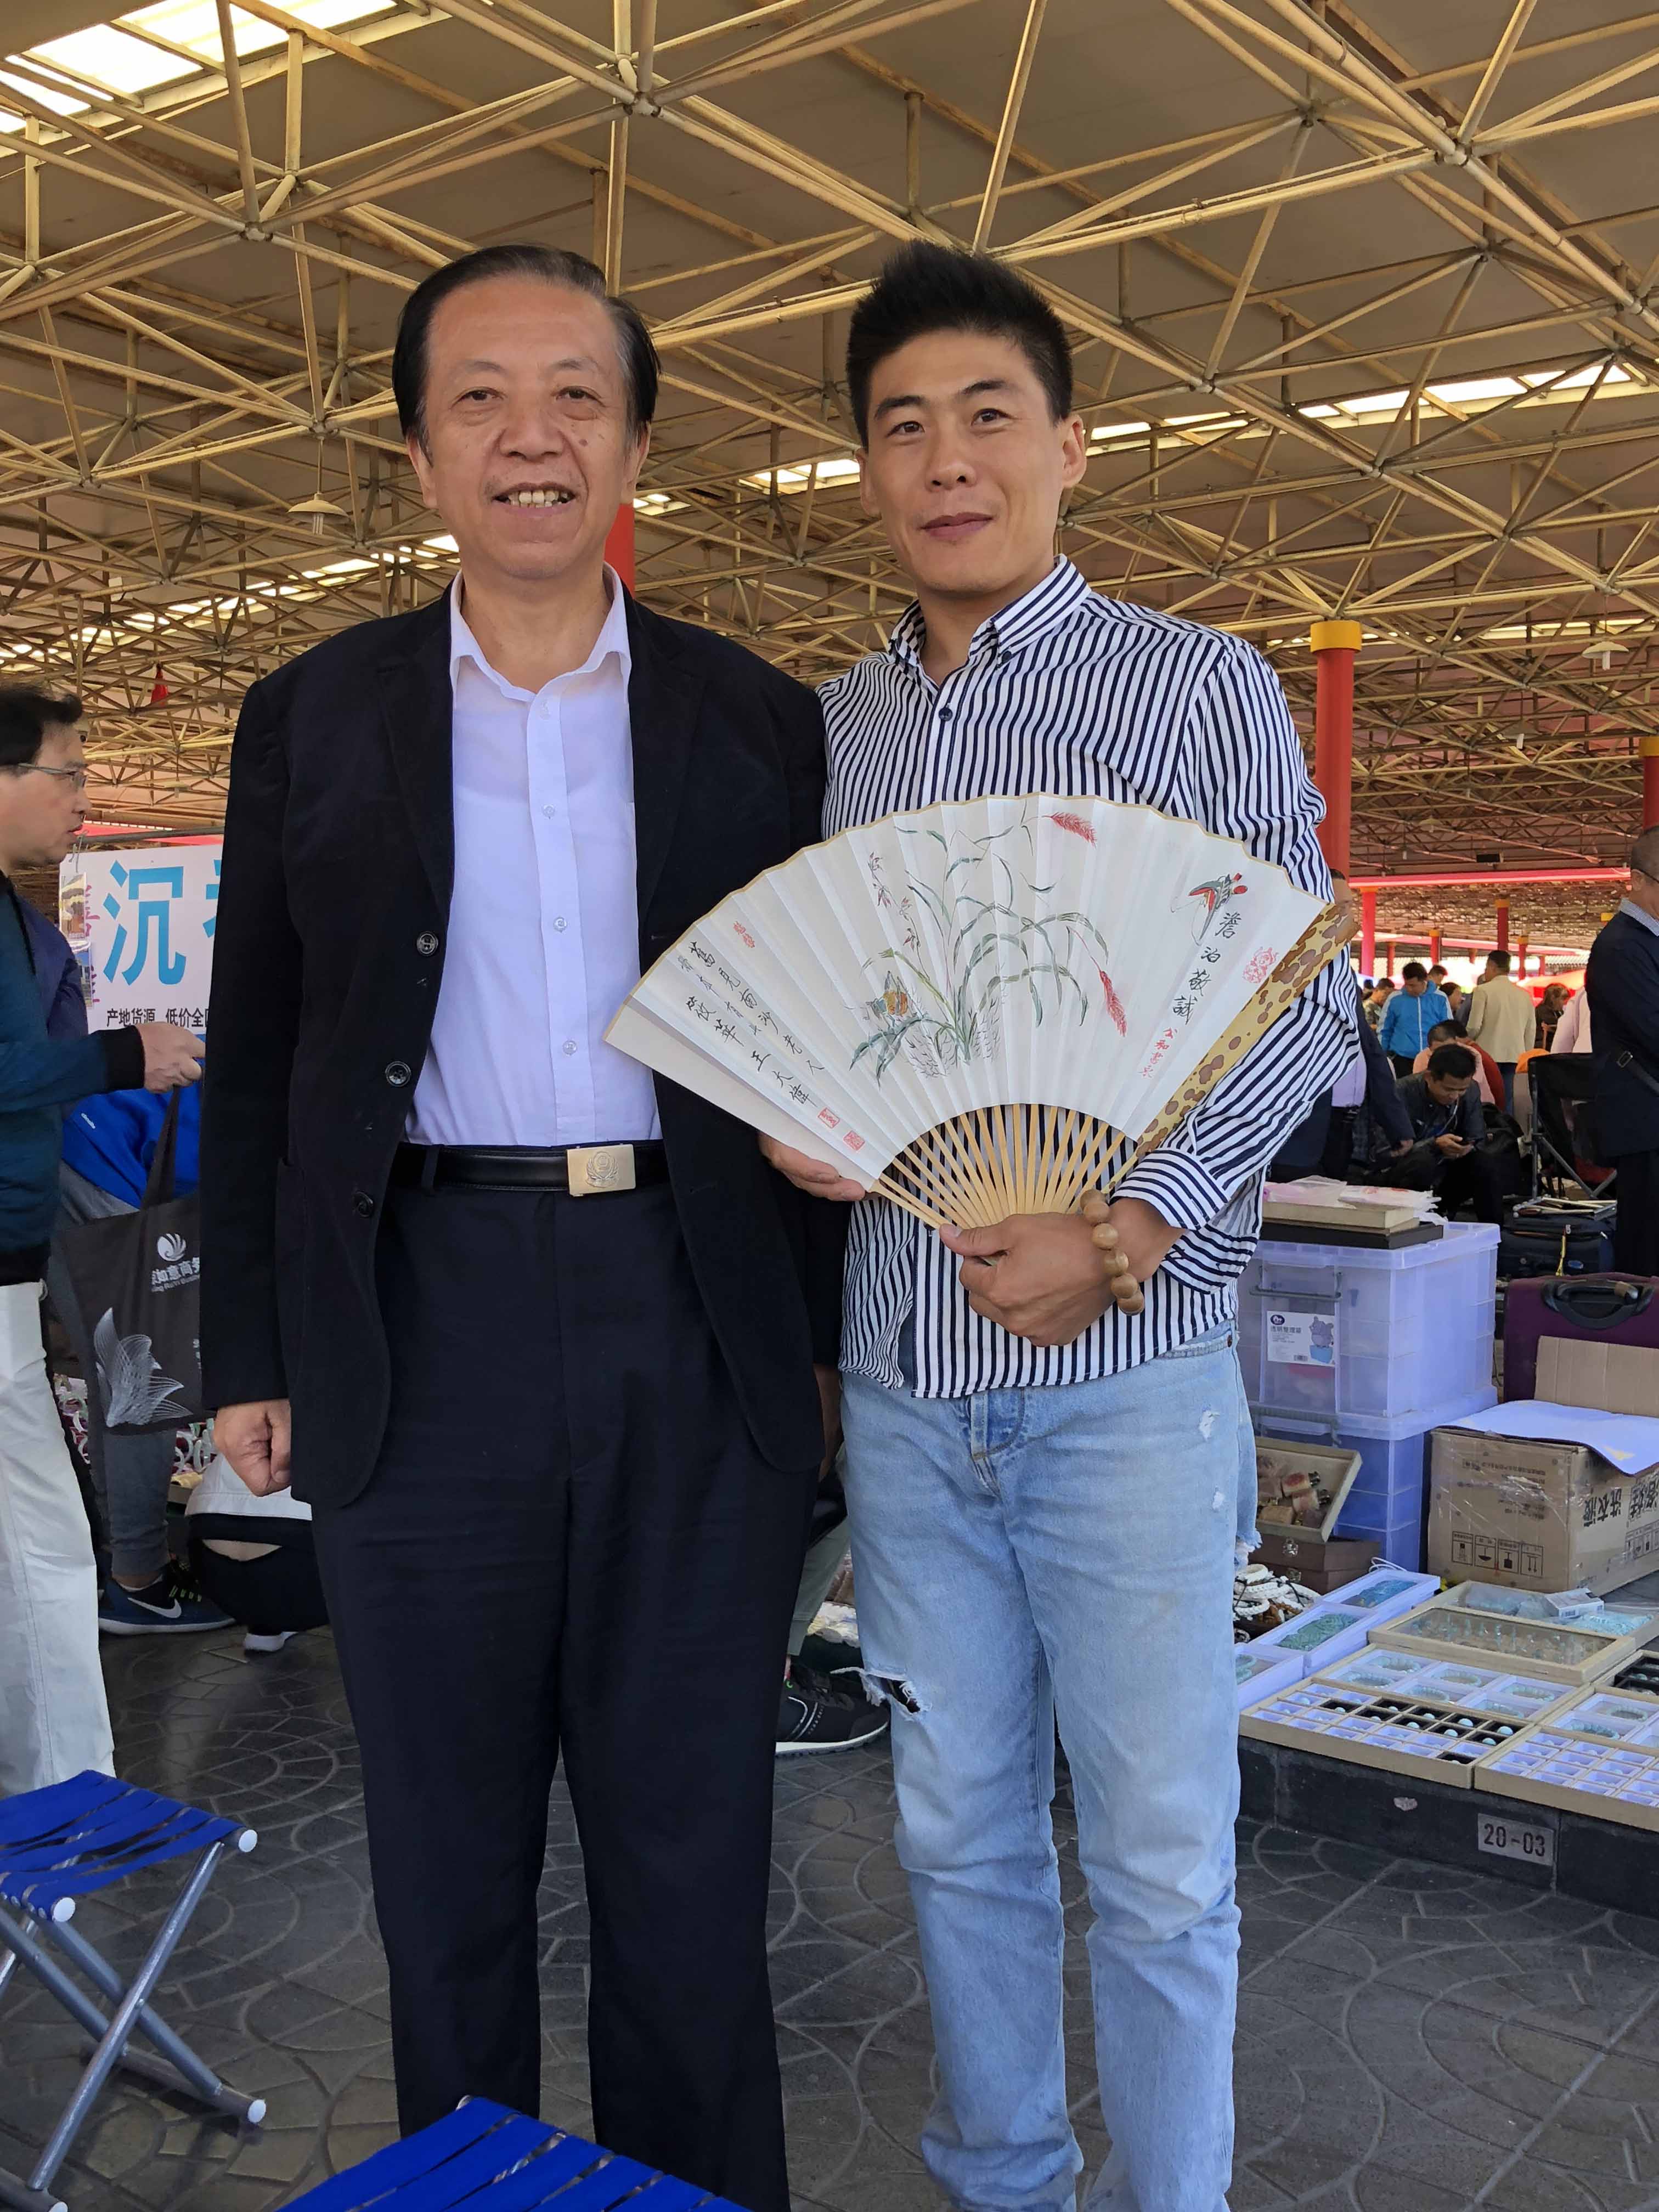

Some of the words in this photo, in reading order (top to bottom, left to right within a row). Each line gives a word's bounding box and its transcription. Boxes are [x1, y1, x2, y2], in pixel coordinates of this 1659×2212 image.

[106, 1008, 156, 1028] 产地货源
[166, 1007, 209, 1028] 低价全
[1583, 1487, 1622, 1527] 洗衣液
[1483, 1822, 1545, 1857] 20-03
